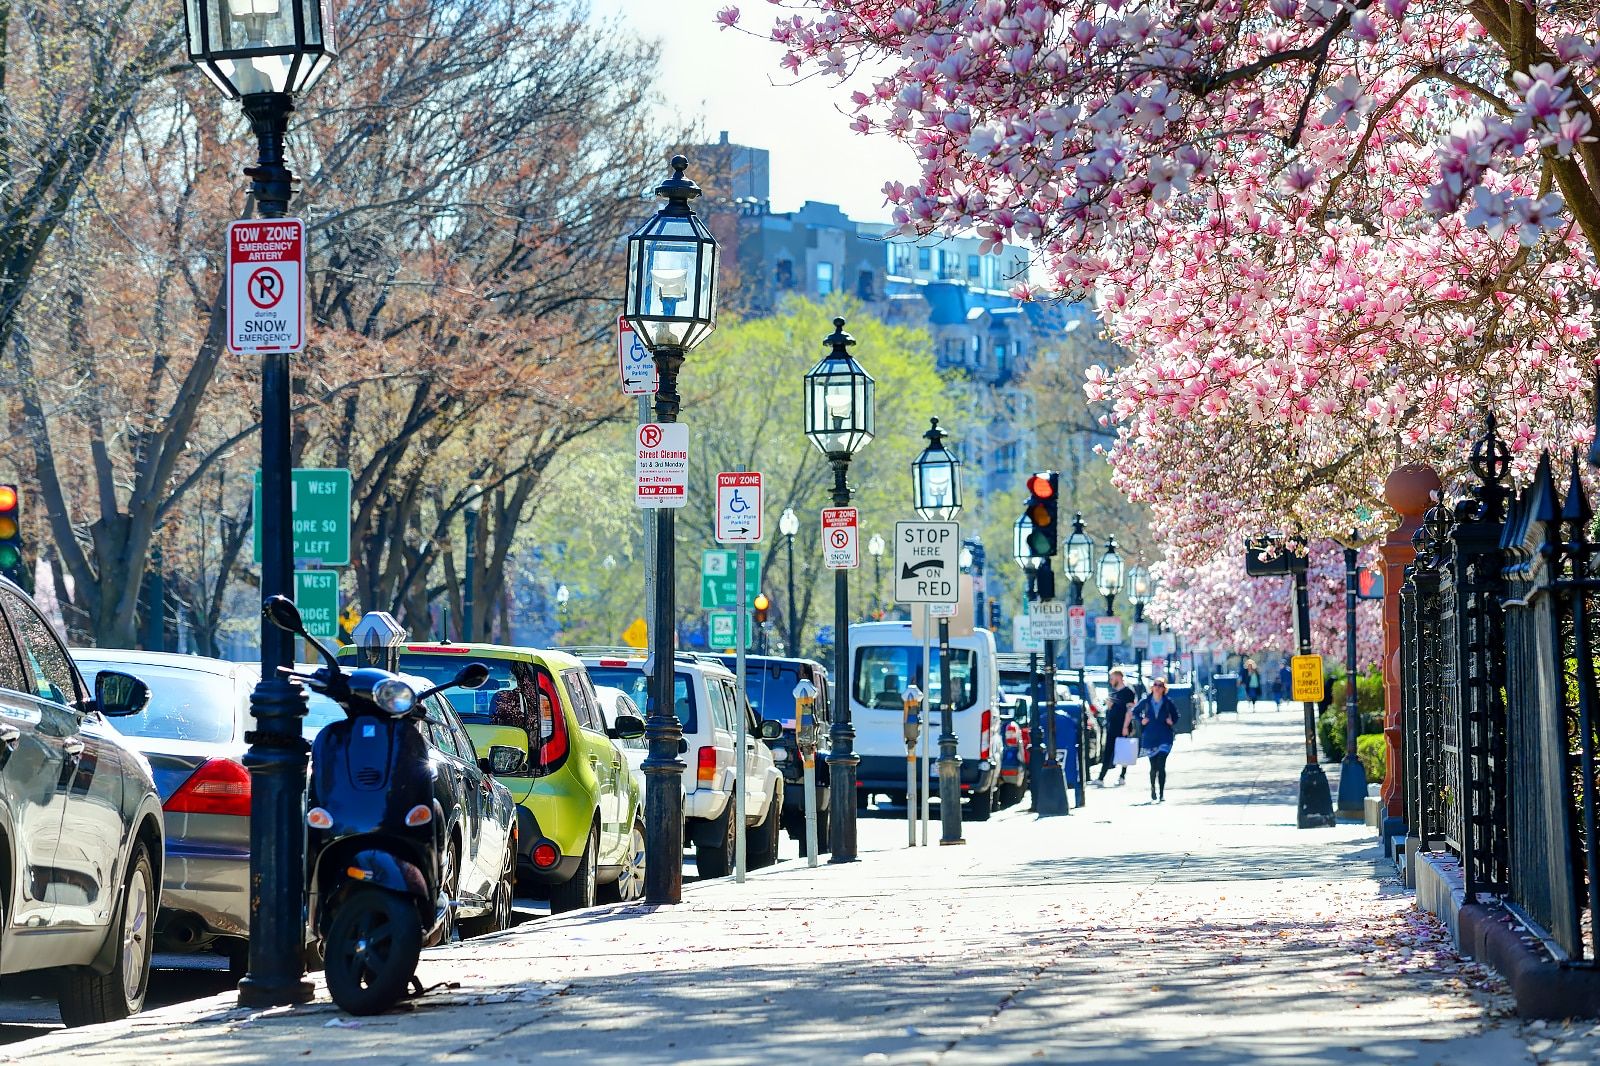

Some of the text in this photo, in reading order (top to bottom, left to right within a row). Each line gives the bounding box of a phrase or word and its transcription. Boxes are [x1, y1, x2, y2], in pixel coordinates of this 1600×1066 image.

[234, 226, 298, 242] TOW ZONE
[239, 242, 292, 252] EMERGENCY
[248, 252, 283, 260] ARTERY
[244, 320, 287, 332] SNOW
[240, 334, 292, 342] EMERGENCY
[639, 450, 686, 460] Street Cleaning
[740, 476, 759, 484] ZONE
[308, 480, 338, 494] WEST
[905, 528, 950, 543] STOP
[304, 540, 330, 554] LEFT
[913, 546, 940, 556] HERE
[926, 569, 941, 578] ON
[302, 574, 331, 588] WEST
[918, 581, 951, 596] RED
[1033, 604, 1062, 614] YIELD
